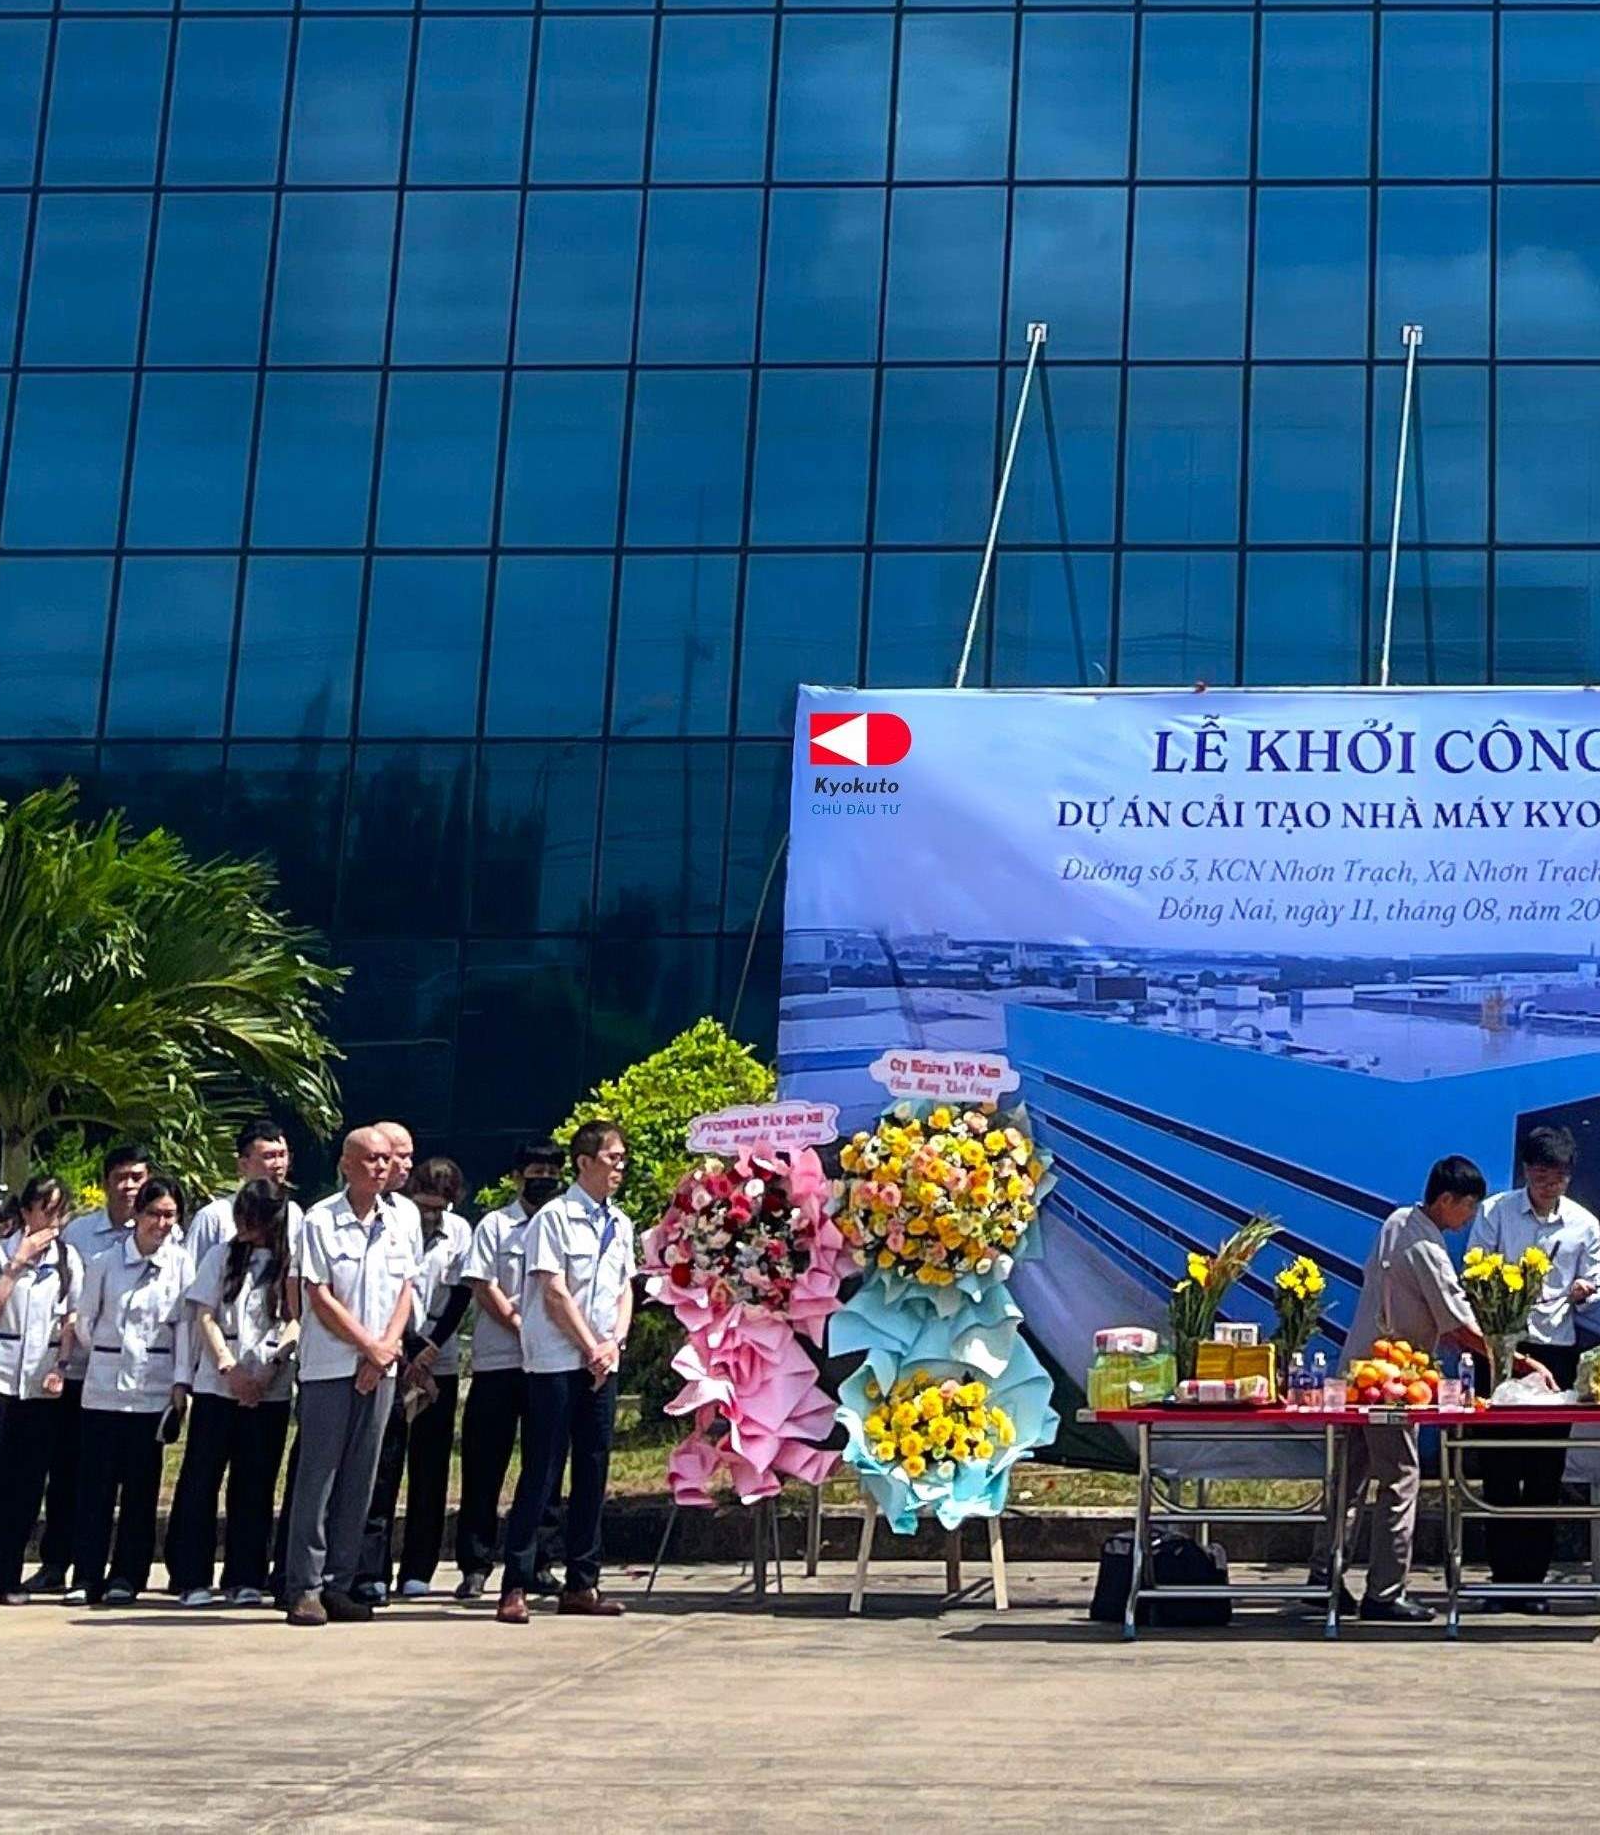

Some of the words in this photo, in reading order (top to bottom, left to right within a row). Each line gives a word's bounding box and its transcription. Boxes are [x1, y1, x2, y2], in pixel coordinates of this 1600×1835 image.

[1152, 714, 1229, 773] LỄ
[1246, 718, 1416, 774] KHỞI
[814, 777, 899, 796] Kyokuto
[1058, 795, 1115, 834] DỰ
[1118, 794, 1172, 828] ÁN
[1181, 793, 1245, 828] CẢI
[1255, 800, 1332, 835] TẠO
[1341, 795, 1424, 829] NHÀ
[1433, 795, 1515, 829] MÁY
[1147, 857, 1178, 881] số
[1180, 858, 1199, 884] 3,
[1207, 858, 1267, 882] KCN
[1269, 858, 1335, 882] Nhơn
[1344, 858, 1418, 886] Trạch,
[1424, 859, 1457, 882] Xã
[1463, 859, 1527, 883] Nhơn
[1229, 896, 1277, 924] Nai,
[1285, 898, 1345, 928] ngày
[1349, 897, 1378, 924] 11,
[1386, 897, 1456, 927] tháng
[1463, 896, 1501, 924] 08,
[1508, 900, 1561, 922] năm
